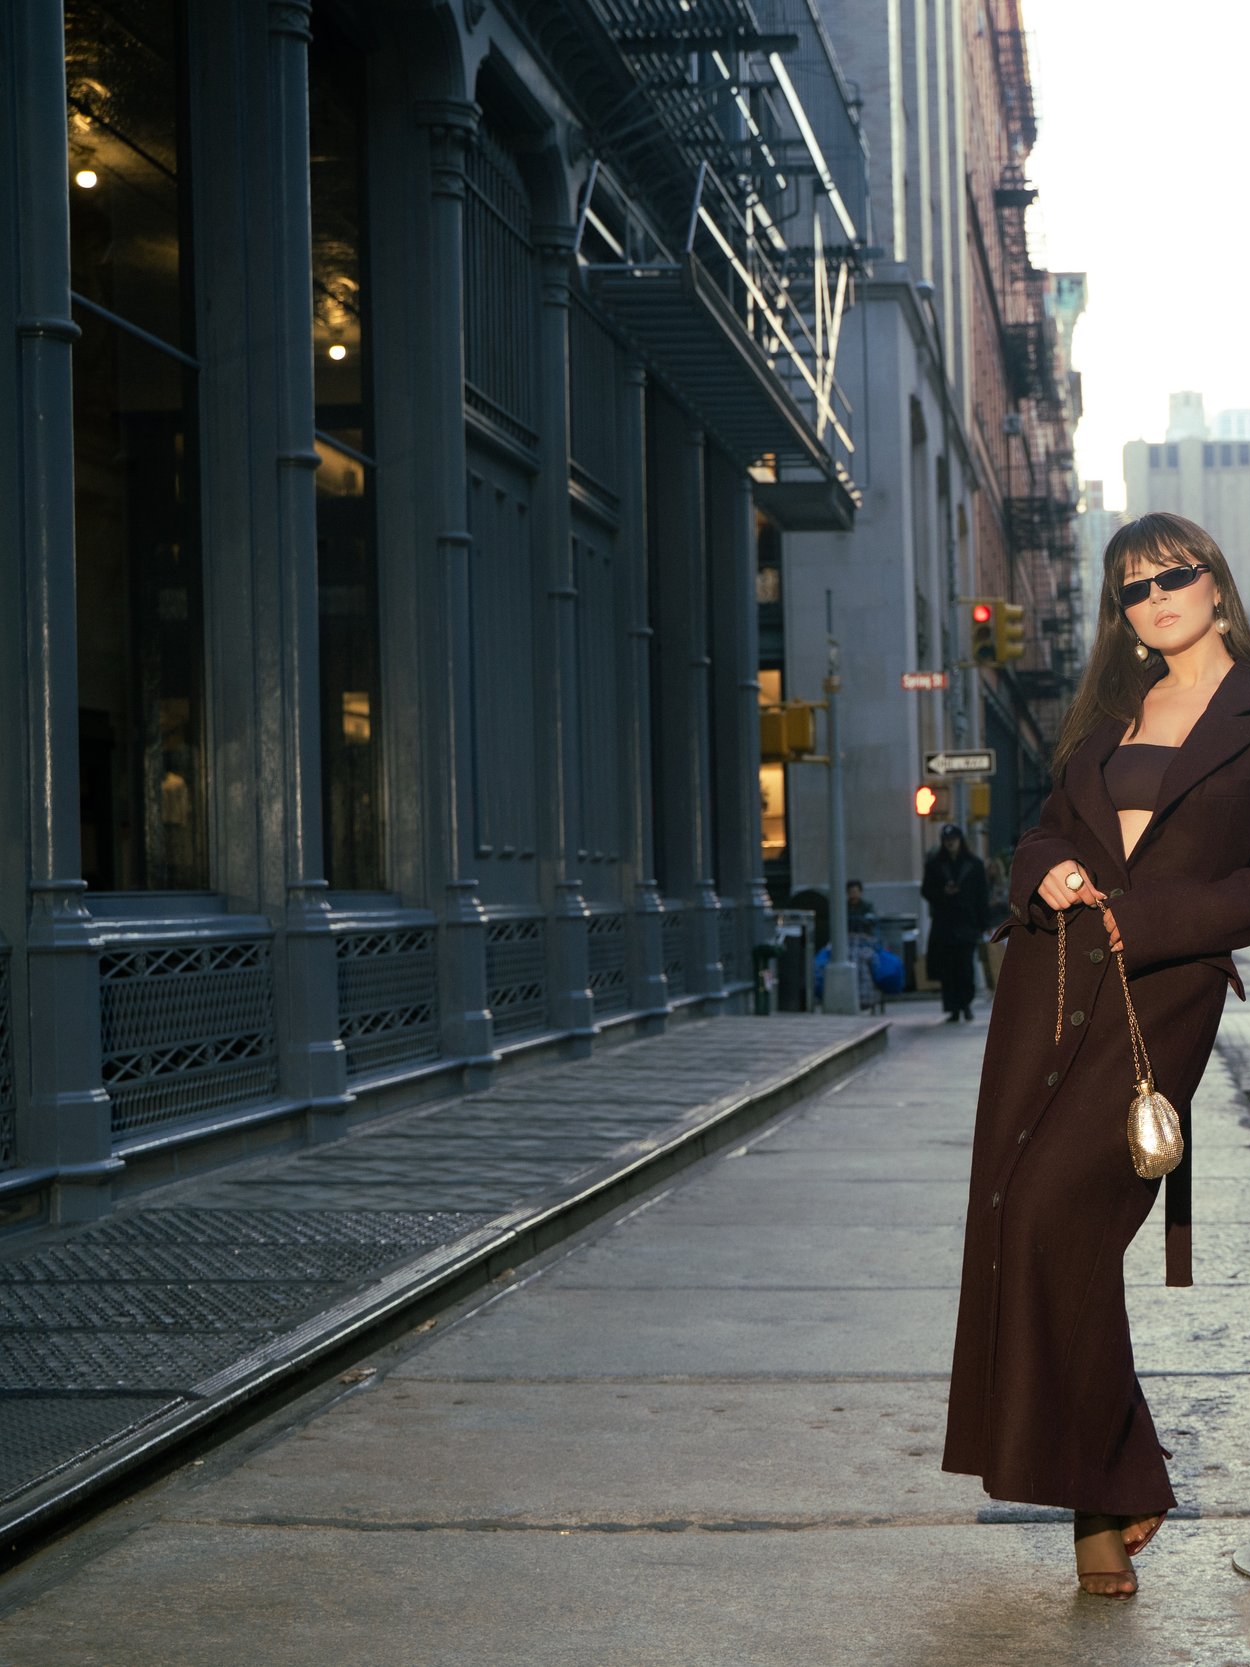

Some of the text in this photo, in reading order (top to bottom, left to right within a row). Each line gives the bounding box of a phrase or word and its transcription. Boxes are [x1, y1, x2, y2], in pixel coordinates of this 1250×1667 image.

[903, 672, 943, 690] Spring St
[964, 757, 984, 770] WAY
